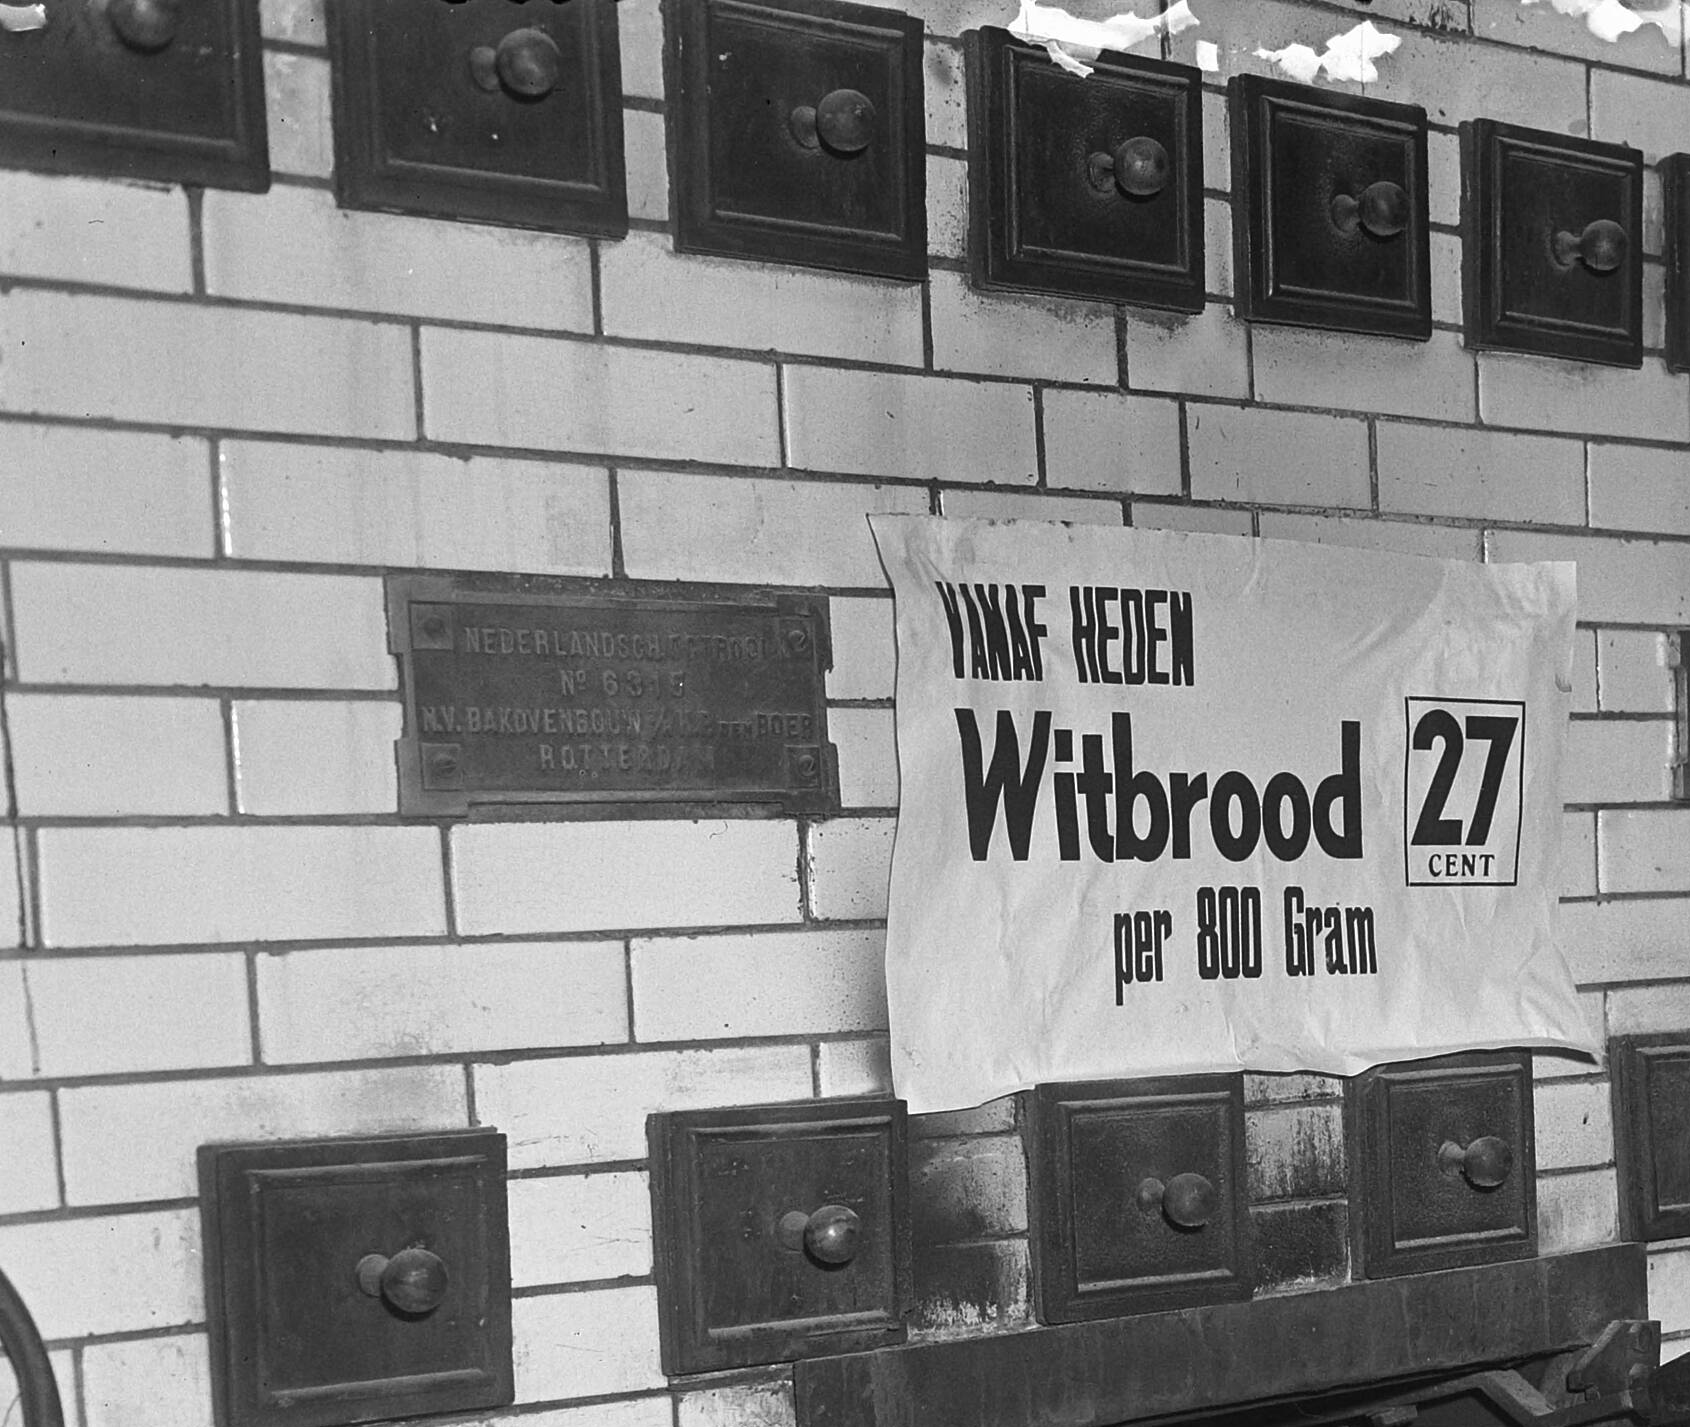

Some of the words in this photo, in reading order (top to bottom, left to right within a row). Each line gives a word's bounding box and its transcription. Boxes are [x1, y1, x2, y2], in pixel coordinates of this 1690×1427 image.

[935, 581, 1048, 682] VANAF
[1069, 585, 1194, 687] HEDEN
[954, 708, 1364, 863] Witbrood
[1410, 708, 1520, 847] 27
[1428, 853, 1496, 878] CENT
[1113, 907, 1173, 1006] per
[1196, 885, 1263, 980] 800
[1284, 885, 1379, 978] Gram
